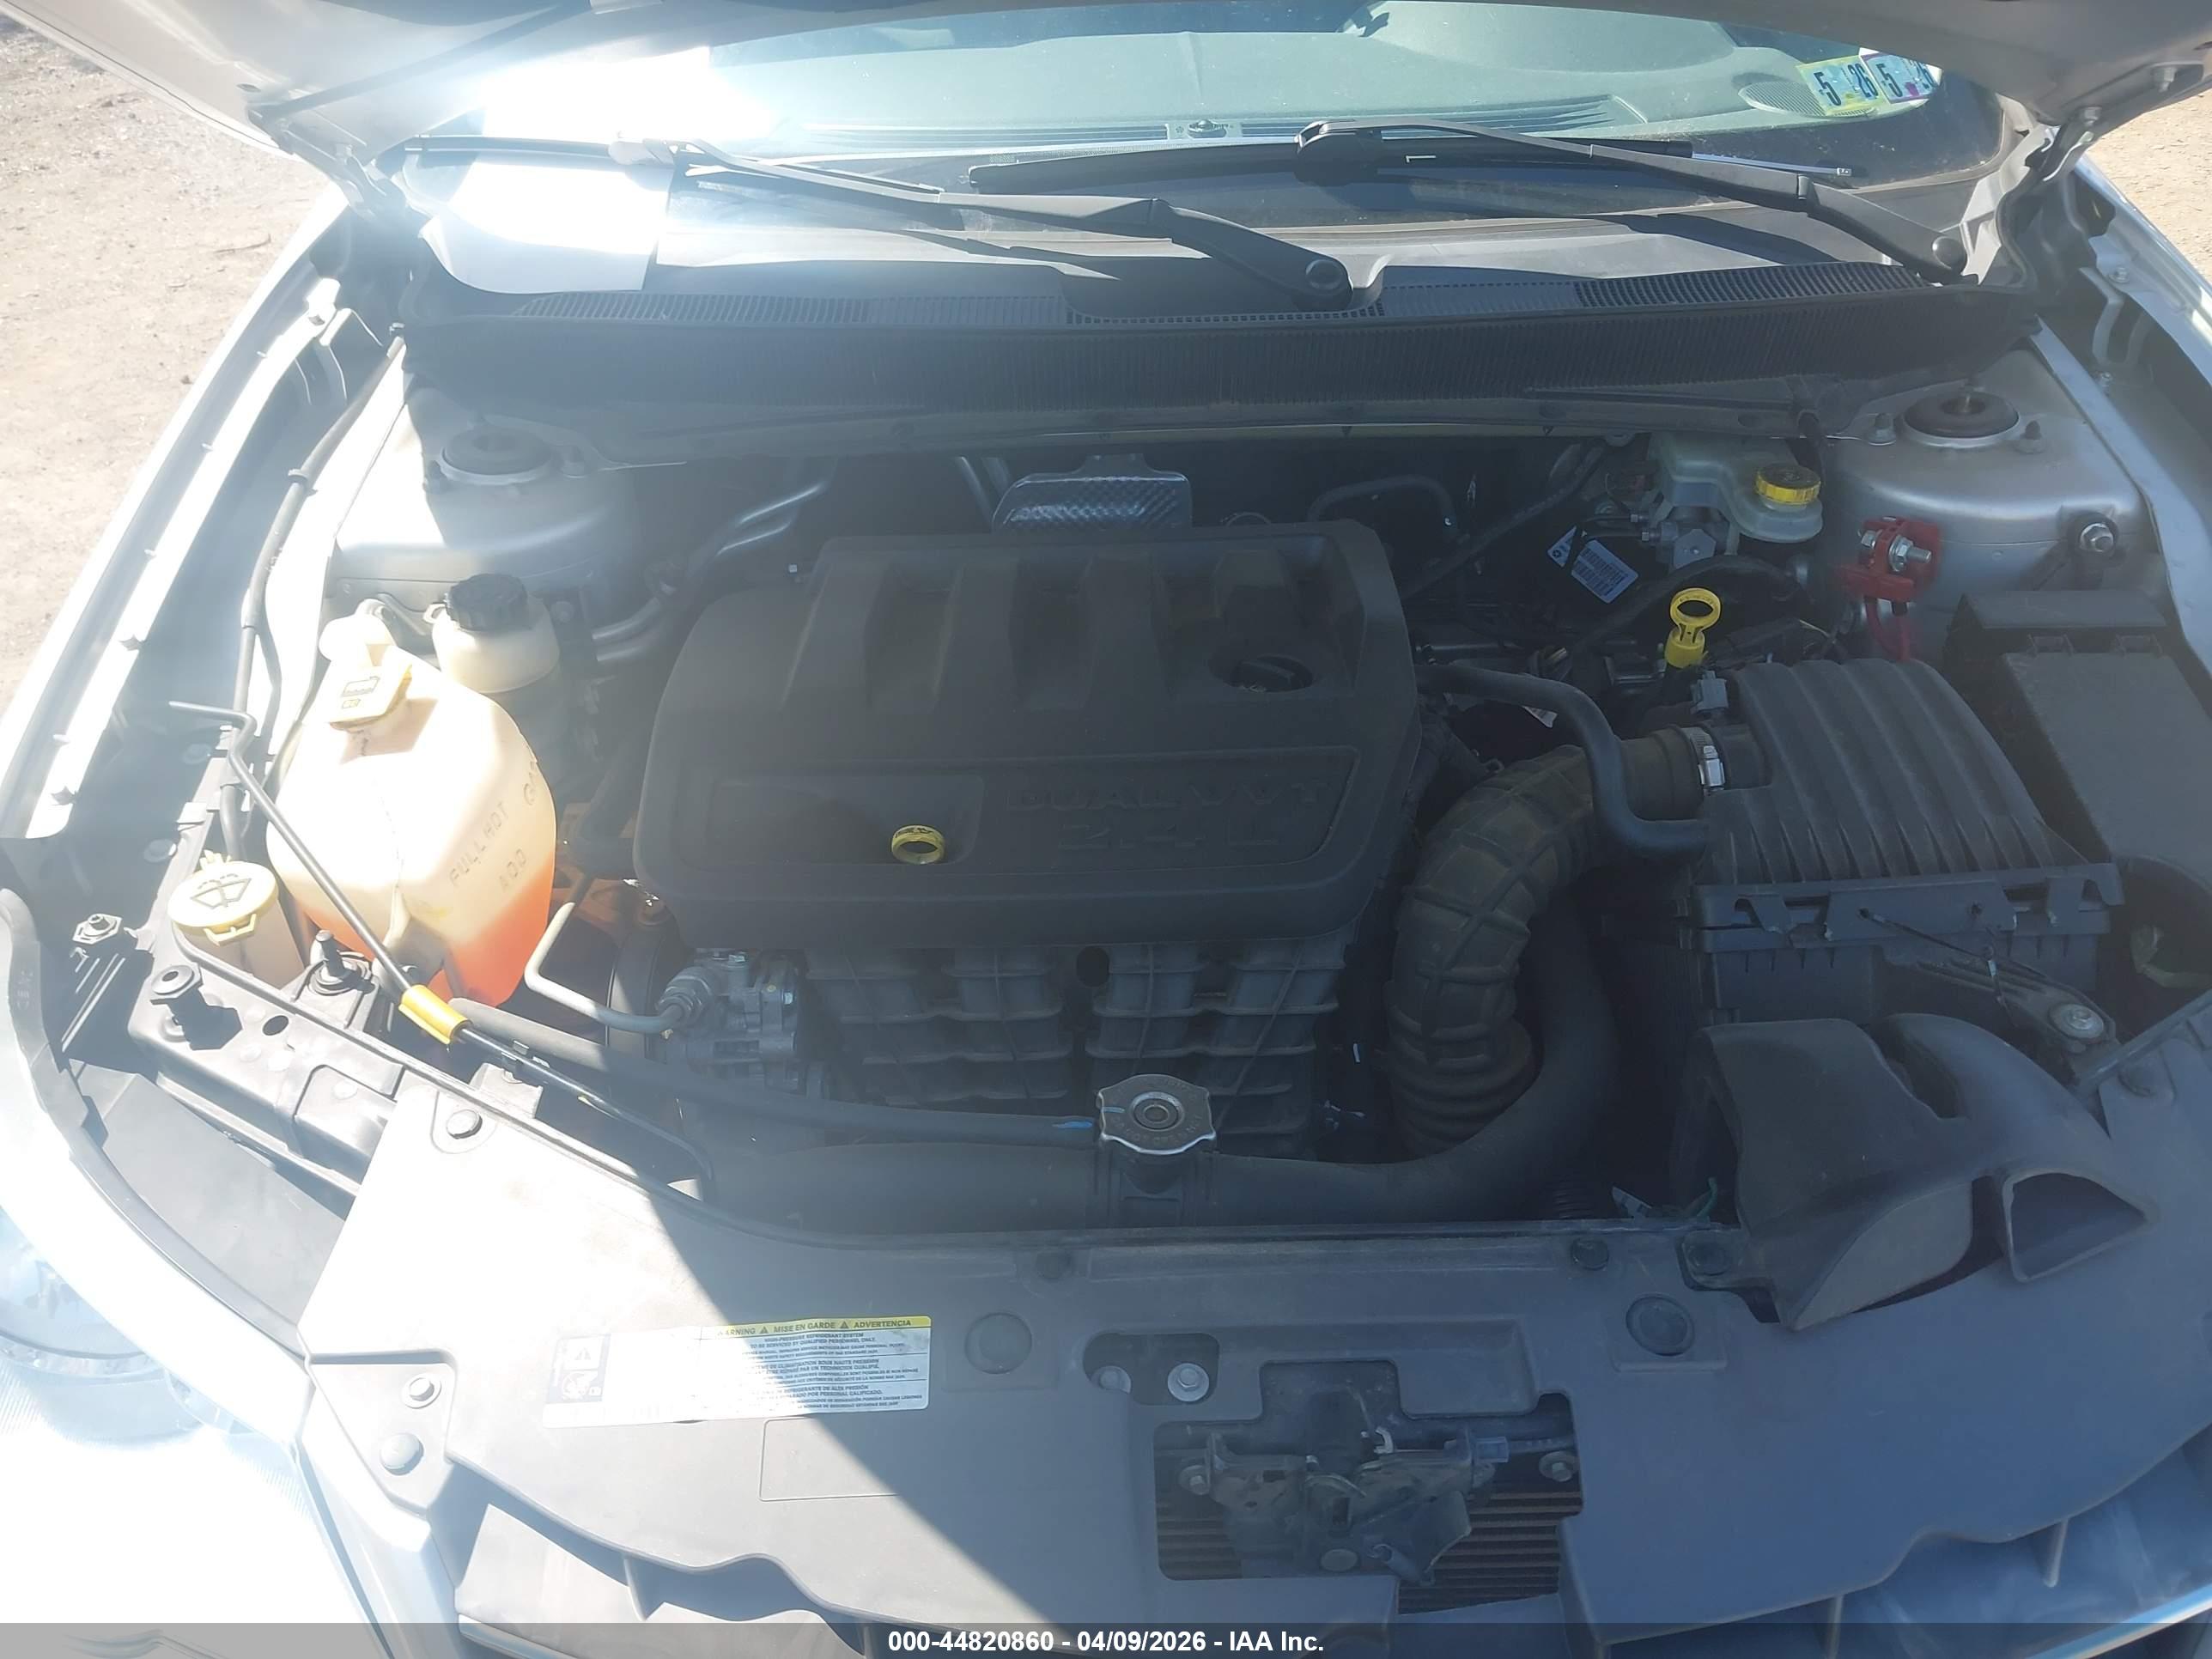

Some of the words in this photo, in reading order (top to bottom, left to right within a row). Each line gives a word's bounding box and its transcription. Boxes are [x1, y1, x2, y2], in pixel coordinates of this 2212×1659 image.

[1847, 63, 1879, 99] 26
[716, 1327, 756, 1336] ARNING
[807, 1321, 836, 1330] GARDE
[854, 1320, 911, 1328] ADVERTENCIA
